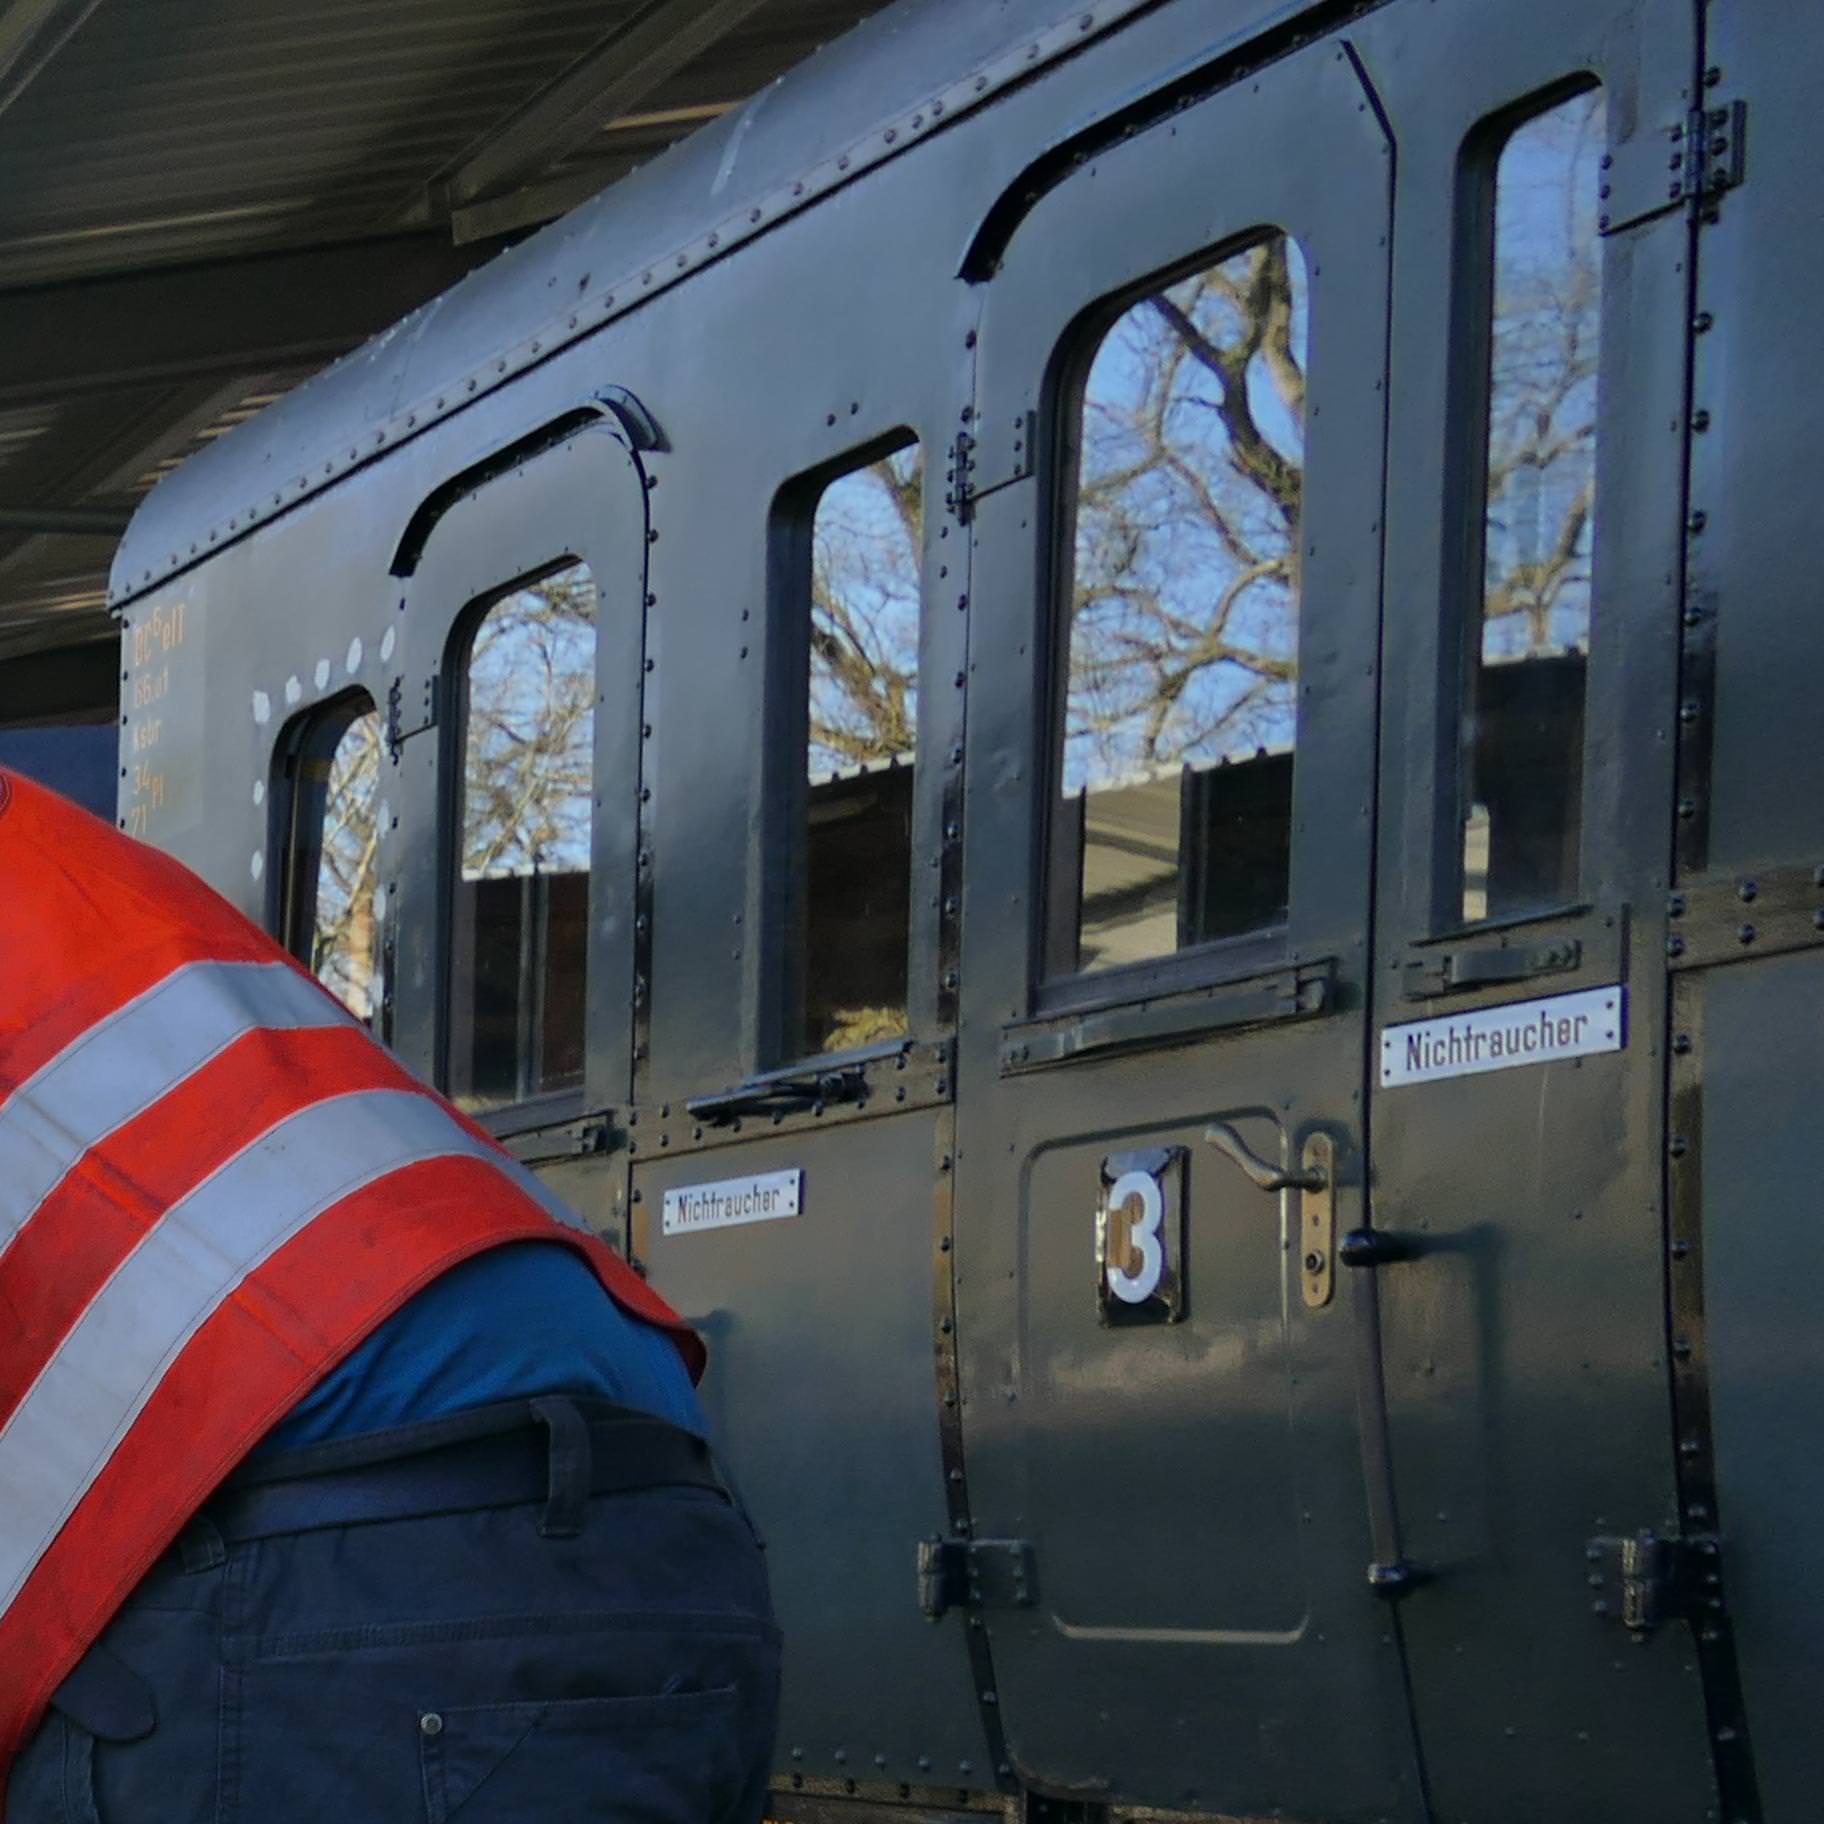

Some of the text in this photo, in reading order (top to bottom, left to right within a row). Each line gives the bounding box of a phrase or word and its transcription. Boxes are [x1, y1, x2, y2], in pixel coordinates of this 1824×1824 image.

[1405, 1005, 1590, 1071] Nichtraucher
[676, 1185, 782, 1224] Nichtraucher
[1106, 1170, 1164, 1305] 3
